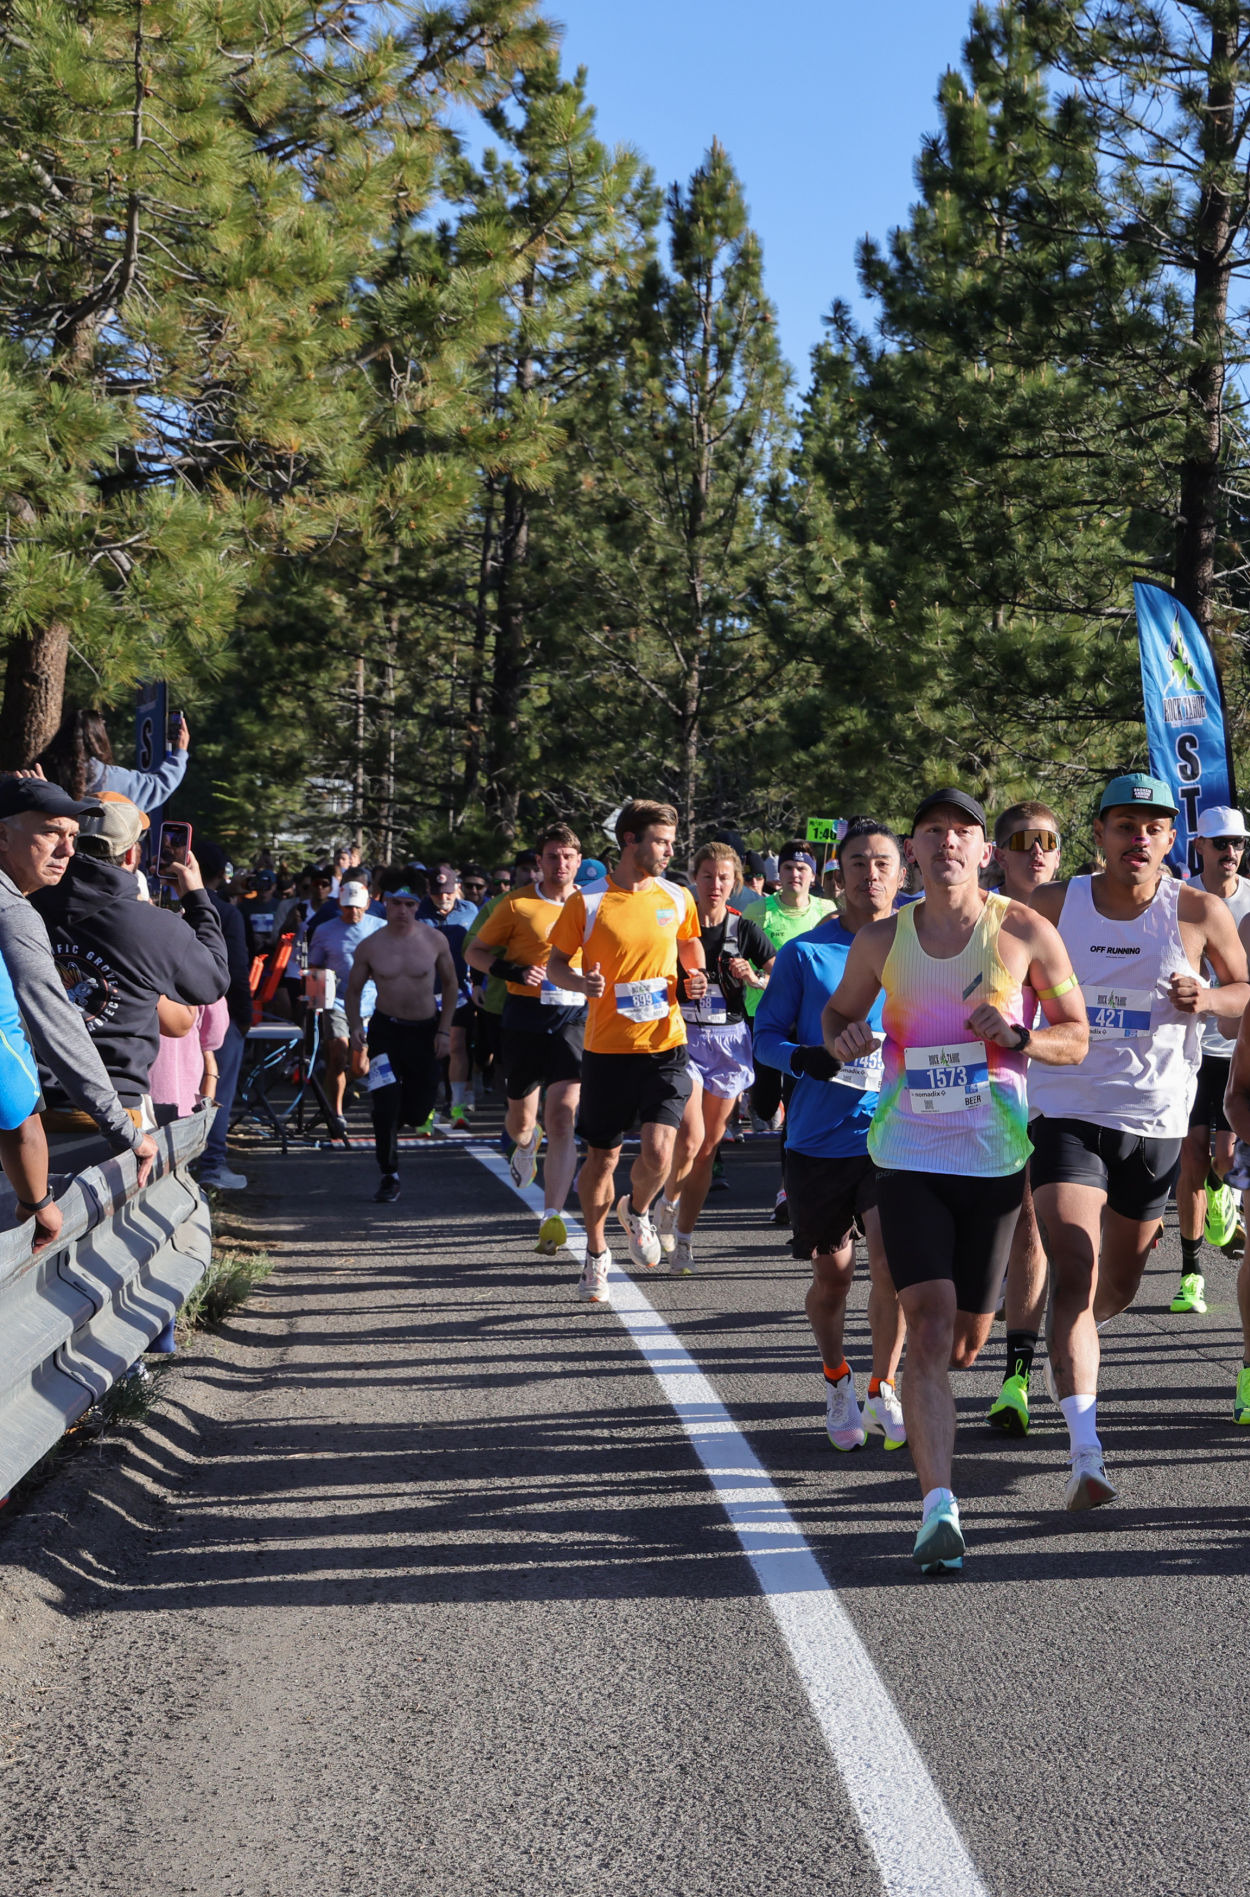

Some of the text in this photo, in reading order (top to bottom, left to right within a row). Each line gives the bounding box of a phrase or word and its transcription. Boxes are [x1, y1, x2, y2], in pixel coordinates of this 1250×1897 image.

[1163, 694, 1207, 722] ROCK TAHOE
[1090, 945, 1141, 955] OFF RUNNING
[86, 951, 119, 987] GROVE
[632, 993, 653, 1007] 899
[699, 996, 712, 1009] 58
[87, 993, 121, 1032] ROJECT
[1095, 1008, 1125, 1028] 421
[926, 1066, 968, 1089] 1573
[914, 1089, 941, 1097] nomadix
[964, 1095, 982, 1106] BEER
